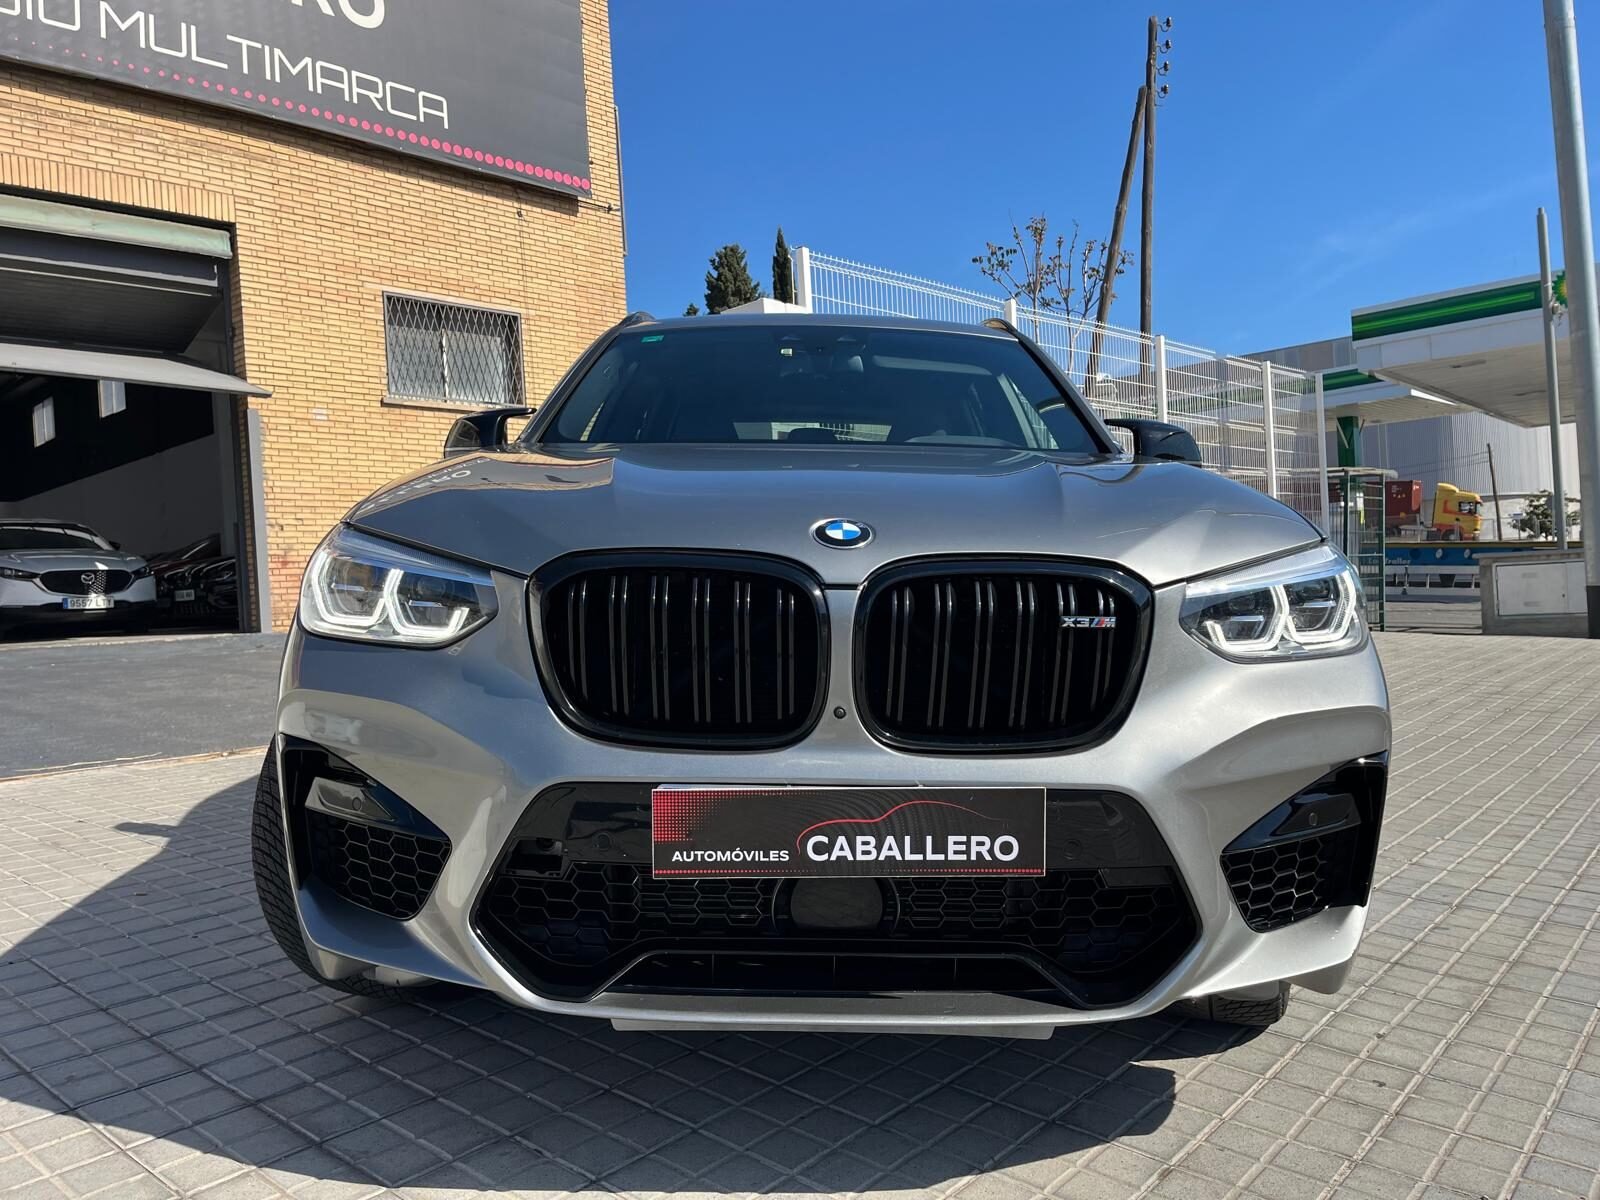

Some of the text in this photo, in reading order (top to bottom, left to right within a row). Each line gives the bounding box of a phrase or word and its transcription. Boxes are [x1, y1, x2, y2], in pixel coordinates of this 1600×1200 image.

[100, 1, 449, 130] MULTIMARCA
[70, 598, 92, 608] 9557
[671, 835, 1020, 862] AUTOMÓVILES CABALLERO
